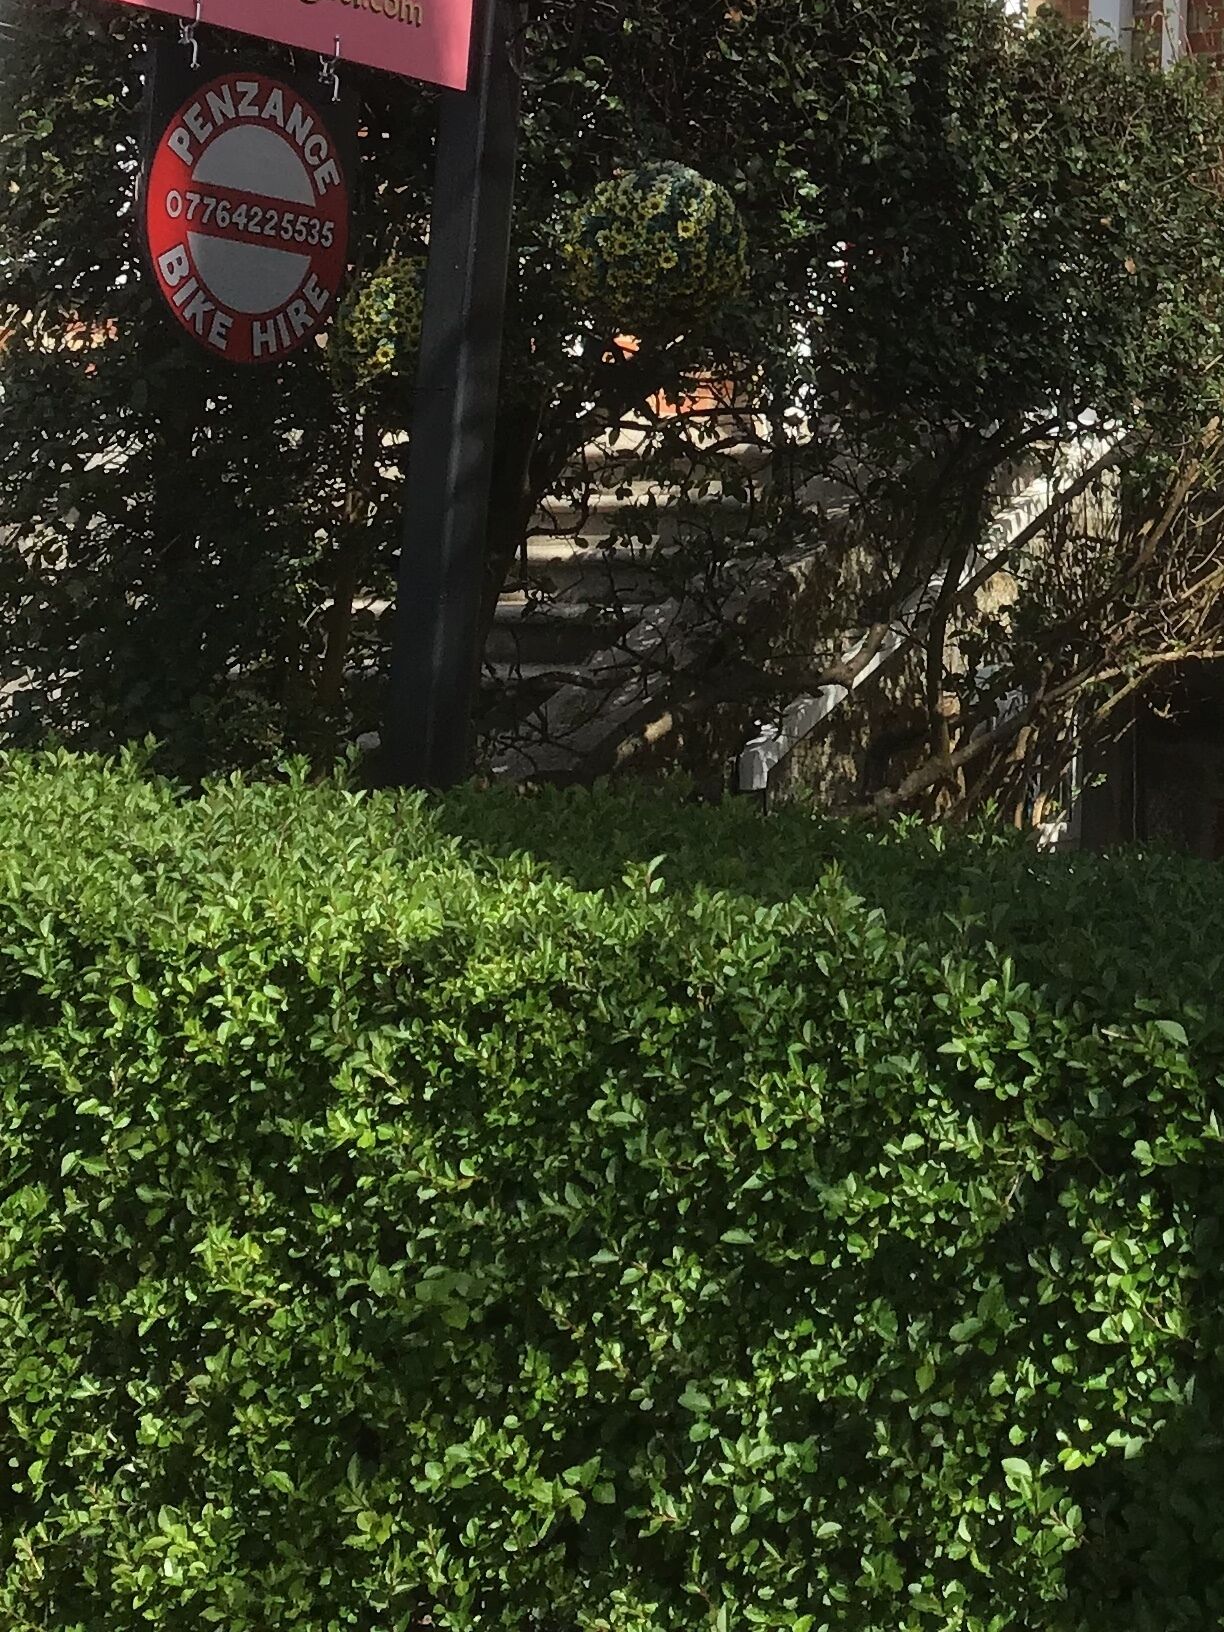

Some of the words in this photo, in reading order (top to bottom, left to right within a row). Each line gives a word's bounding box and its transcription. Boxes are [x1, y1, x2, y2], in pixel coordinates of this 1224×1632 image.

[168, 81, 340, 195] PENZANCE
[166, 189, 335, 248] 07764225535
[158, 244, 234, 351] BIKE
[252, 273, 330, 357] HIRE
